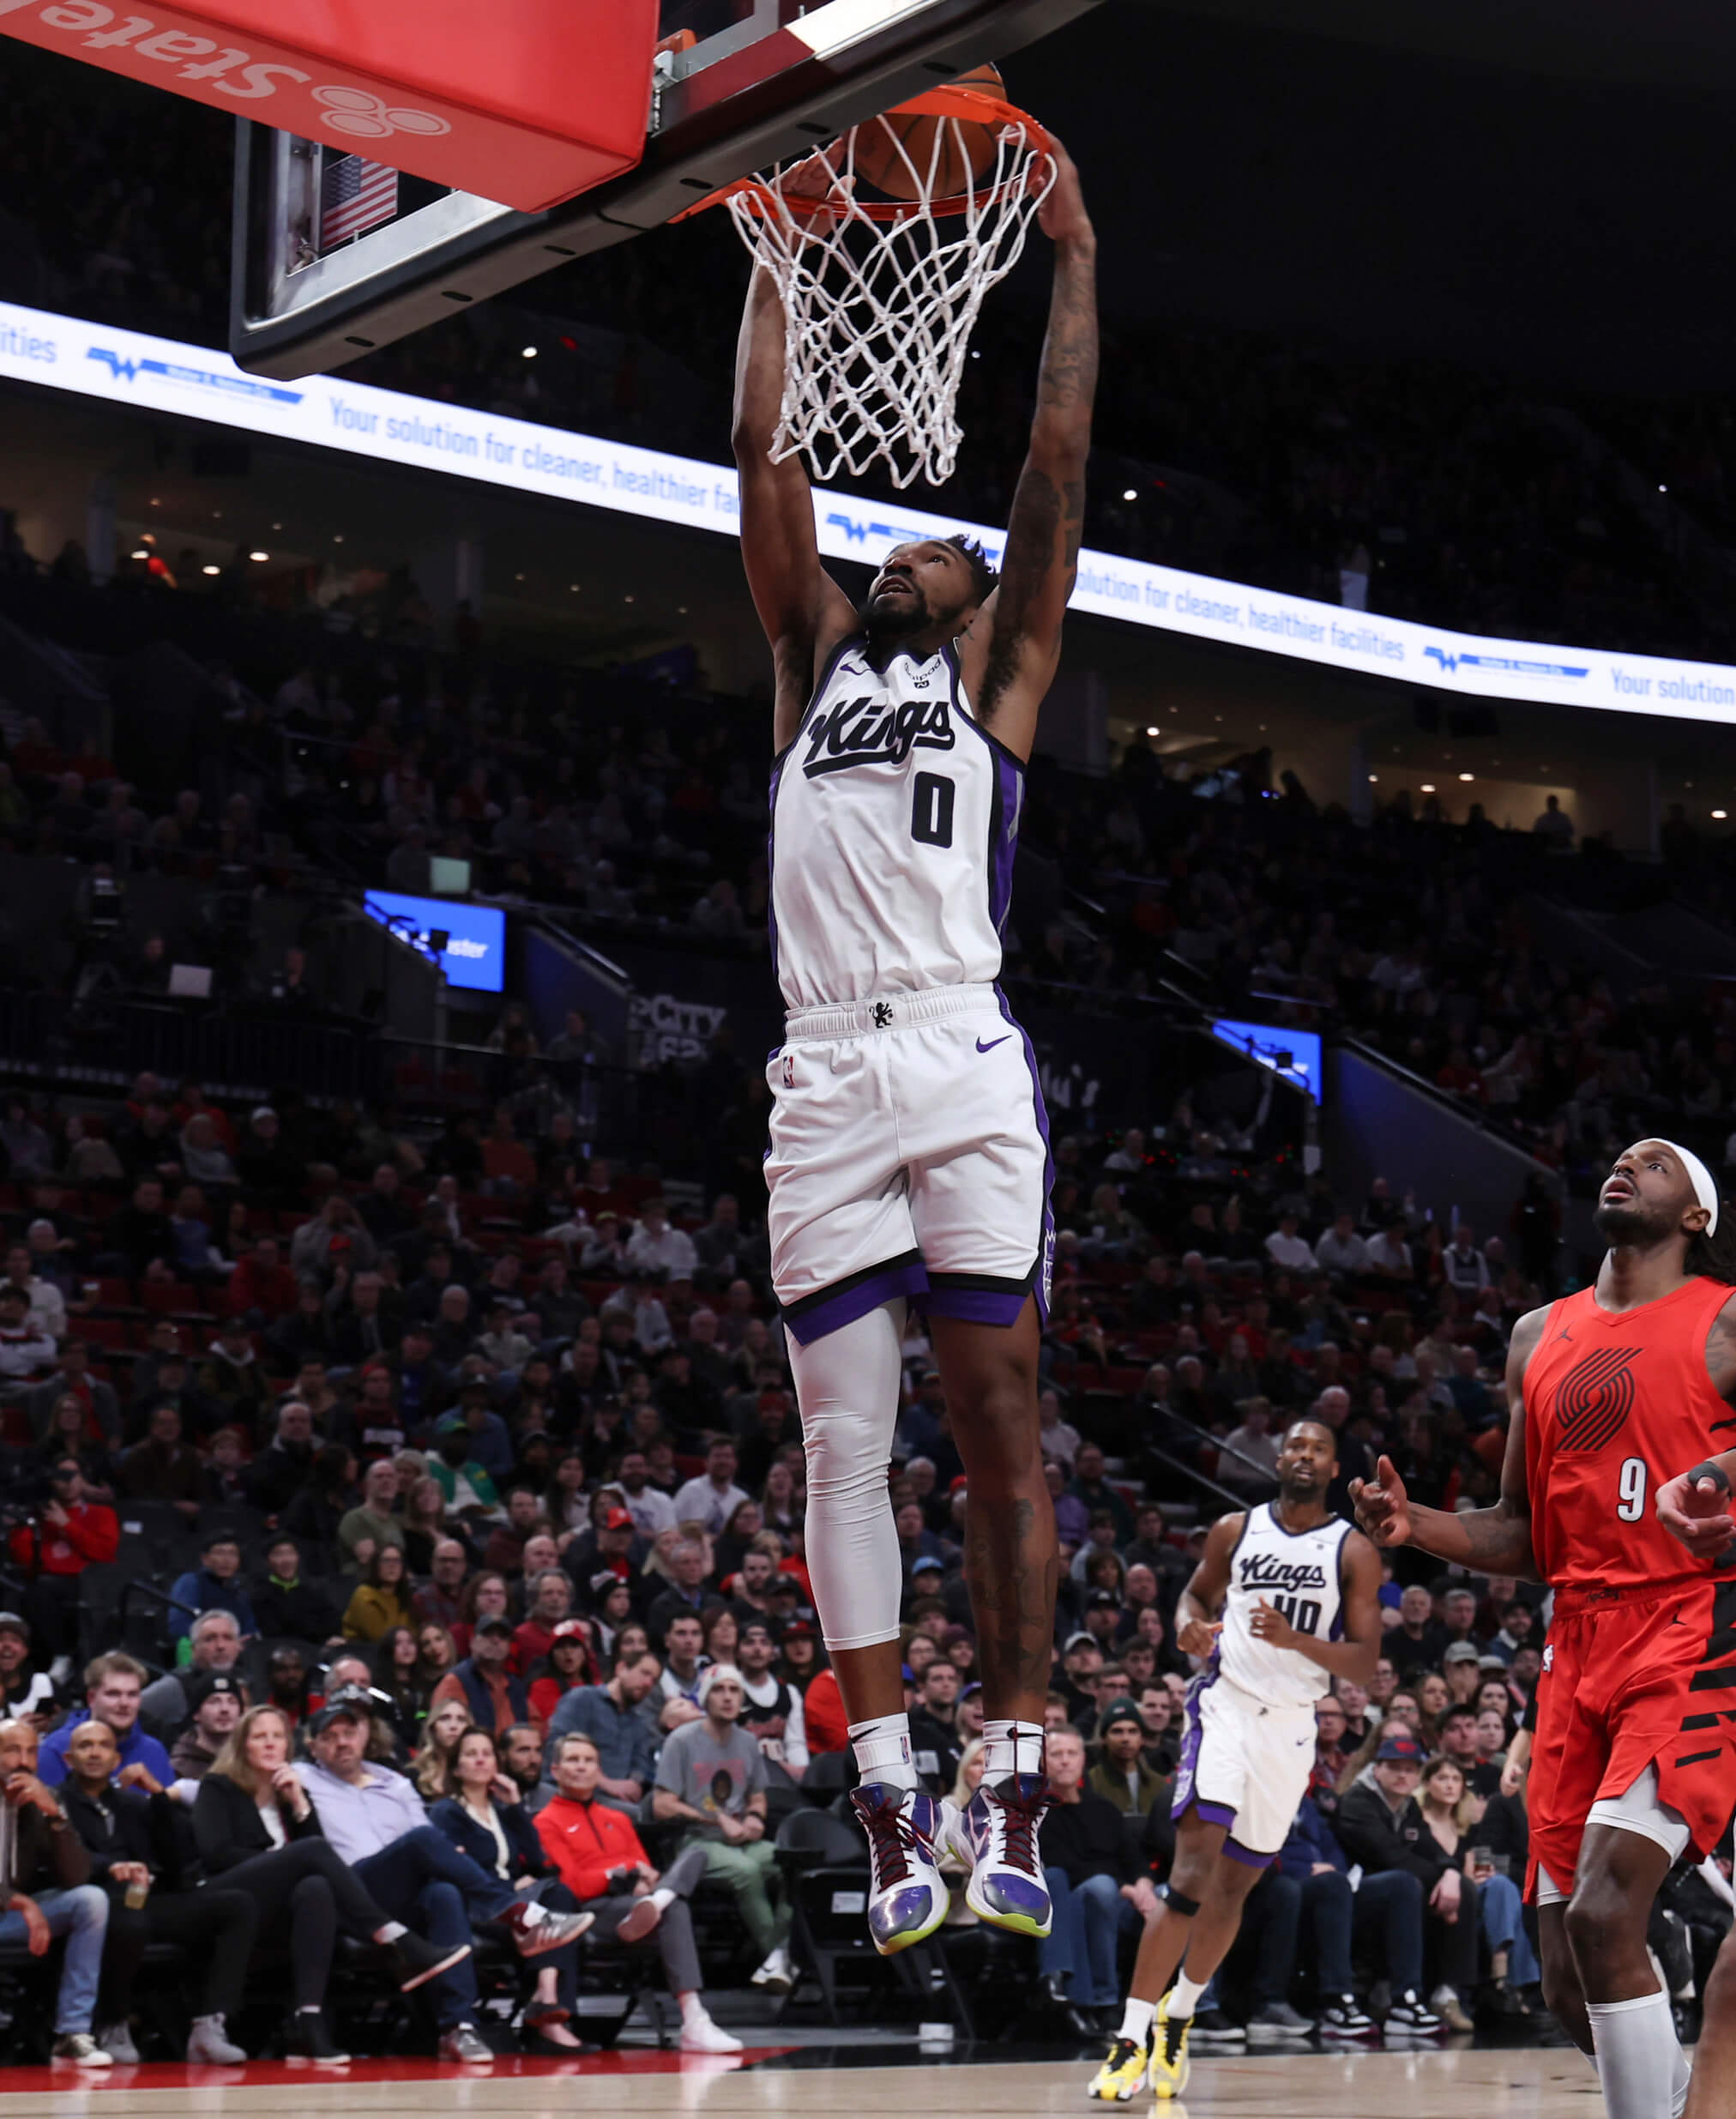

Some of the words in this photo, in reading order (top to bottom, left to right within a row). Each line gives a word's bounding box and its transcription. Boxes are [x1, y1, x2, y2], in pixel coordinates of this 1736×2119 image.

[39, 0, 312, 99] State
[329, 396, 378, 434] Your
[386, 415, 479, 457] solution
[485, 432, 515, 465] for
[521, 443, 607, 488] cleaner,
[613, 460, 708, 508] healthier
[1076, 567, 1140, 604] olution
[1145, 580, 1171, 611] for
[1174, 589, 1244, 629] cleaner,
[1248, 603, 1325, 643] healthier
[1330, 620, 1406, 661] facilities
[1611, 665, 1651, 695] Your
[1657, 674, 1735, 705] solution
[802, 696, 955, 777] Kings
[911, 770, 955, 849] 0
[1617, 1457, 1648, 1523] 9
[1239, 1554, 1326, 1592] Kings
